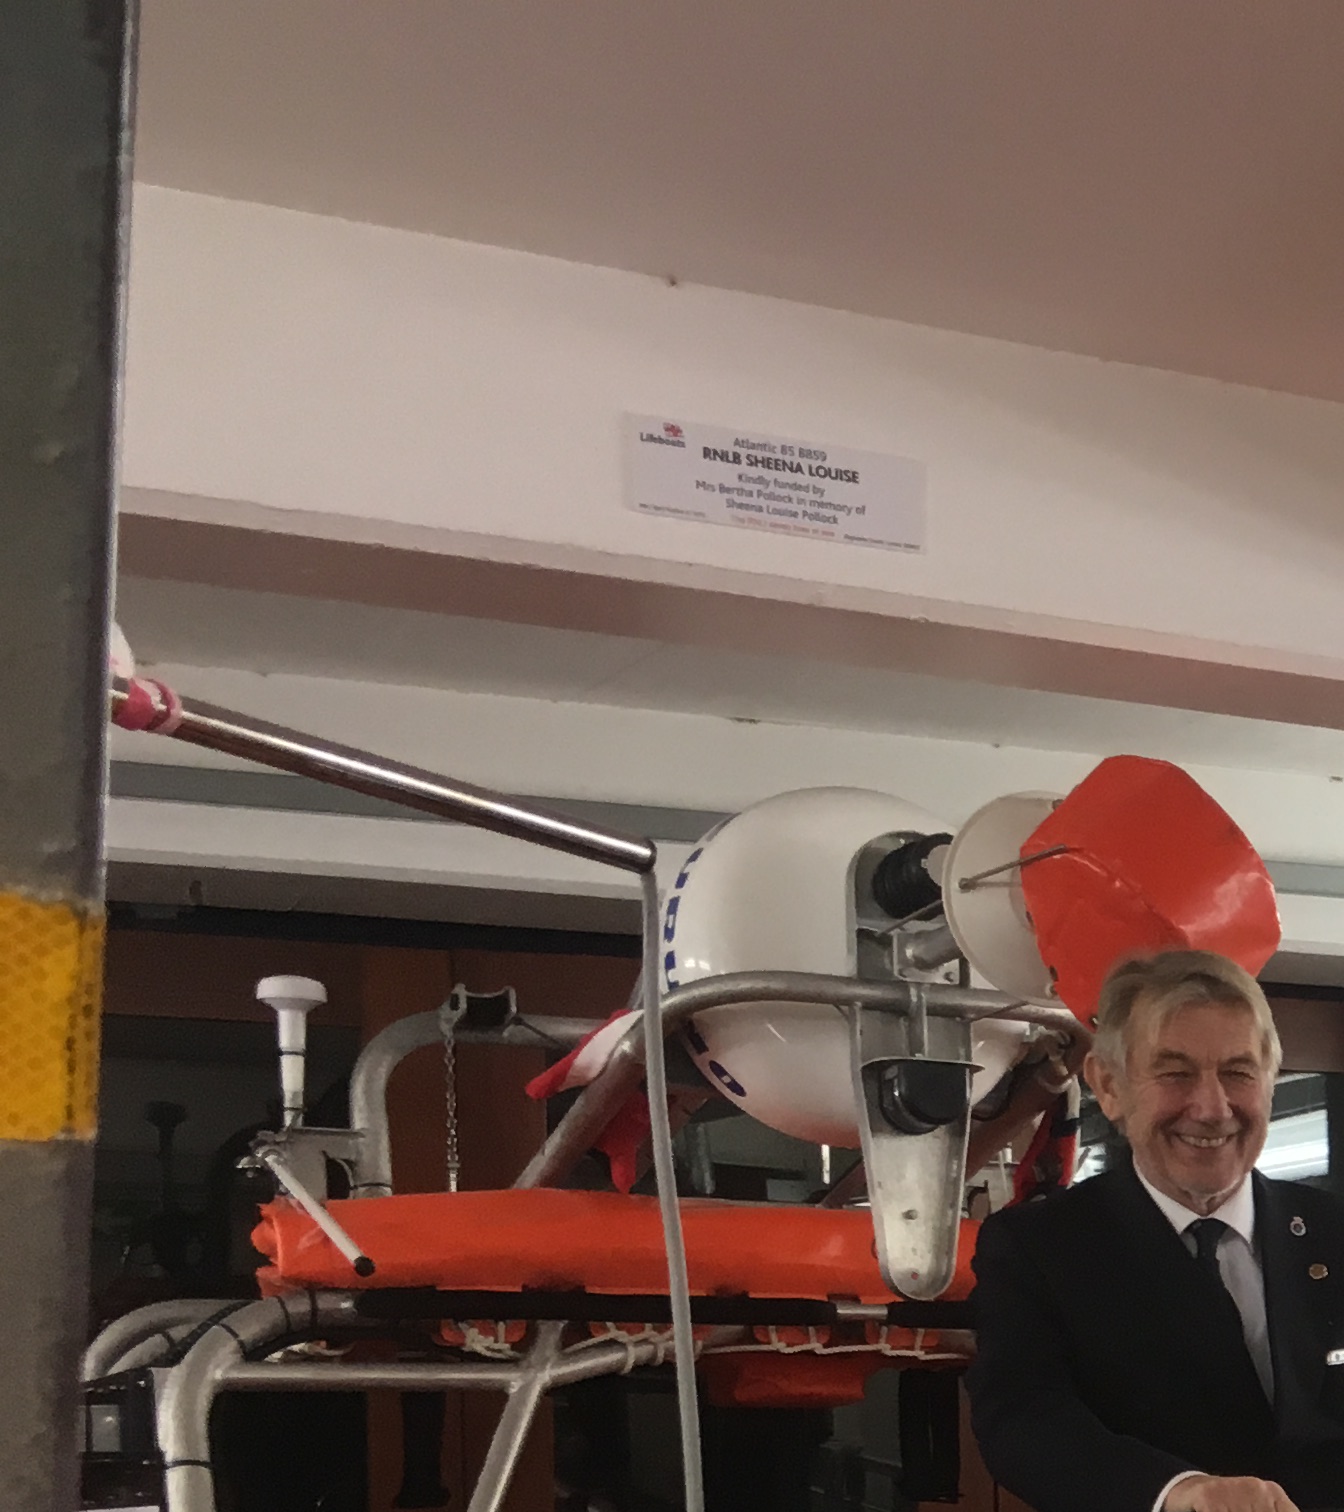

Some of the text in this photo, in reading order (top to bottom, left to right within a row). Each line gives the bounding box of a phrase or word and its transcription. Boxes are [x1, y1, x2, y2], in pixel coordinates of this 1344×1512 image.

[639, 432, 686, 448] Lifeboats
[733, 438, 777, 454] Atlantic
[702, 446, 860, 484] RNLB SHEENA LOUISE
[737, 473, 826, 497] Kindly funded by
[696, 480, 866, 516] Mrs Bertha Pollock in memory of
[726, 498, 839, 524] Sheena Louise Pollock
